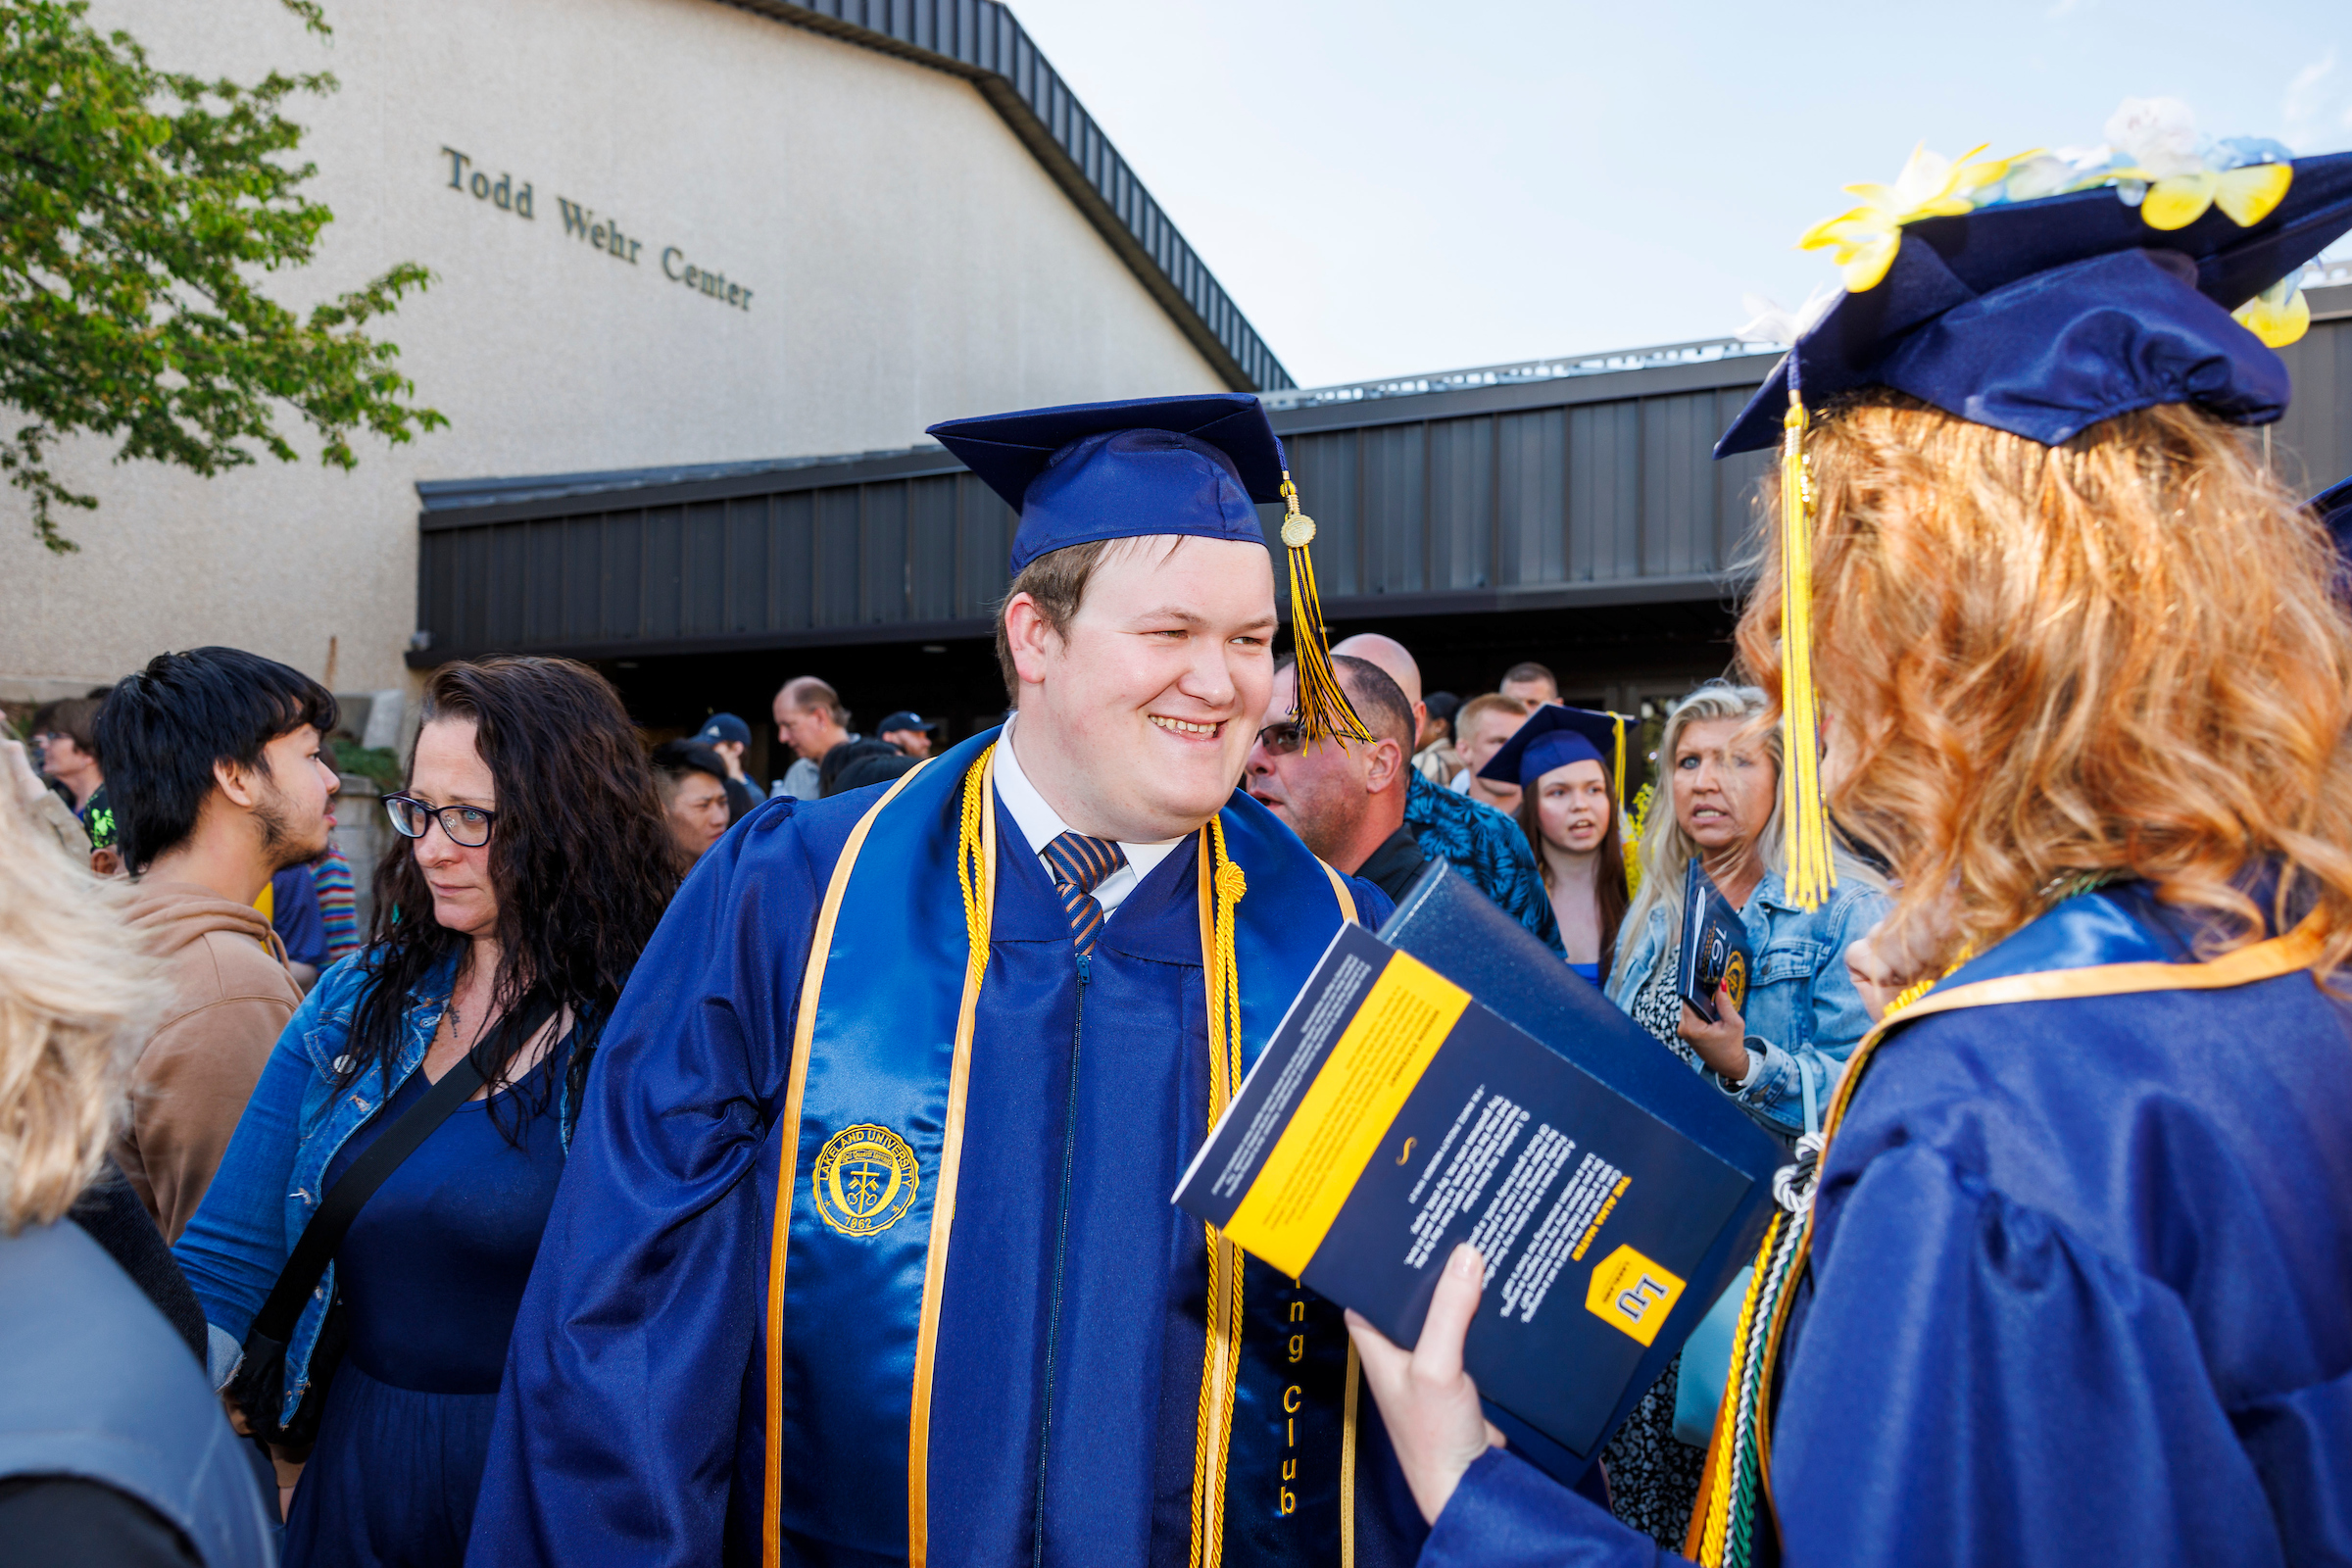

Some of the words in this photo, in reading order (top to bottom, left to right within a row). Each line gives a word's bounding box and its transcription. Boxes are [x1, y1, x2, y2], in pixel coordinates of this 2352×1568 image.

[441, 145, 534, 220] Todd
[557, 196, 642, 265] Wehr
[661, 246, 753, 312] Center
[1495, 1099, 1512, 1118] And
[1483, 1114, 1500, 1134] may
[1544, 1128, 1558, 1144] No
[820, 1131, 864, 1181] LAKELAND
[866, 1130, 914, 1188] UNIVERSITY
[1466, 1145, 1483, 1164] God
[1485, 1154, 1499, 1170] my
[1579, 1152, 1595, 1171] Like
[1590, 1157, 1605, 1173] Do
[1595, 1163, 1613, 1183] With
[1474, 1168, 1493, 1191] Alma
[1580, 1169, 1595, 1186] you
[1605, 1168, 1622, 1188] Can
[1612, 1174, 1631, 1198] THE
[1459, 1188, 1480, 1213] Mater
[1518, 1189, 1531, 1203] me
[1594, 1185, 1609, 1200] you
[1553, 1209, 1570, 1228] why
[1577, 1210, 1593, 1229] why
[1592, 1195, 1617, 1226] ALMA
[846, 1216, 872, 1229] 1862
[1545, 1224, 1560, 1240] my
[1428, 1225, 1445, 1243] day
[1500, 1233, 1515, 1248] my
[1569, 1226, 1583, 1241] my
[1571, 1224, 1598, 1261] MATER
[1422, 1239, 1436, 1253] by
[1616, 1272, 1669, 1324] LU
[1280, 1385, 1302, 1515] Club
